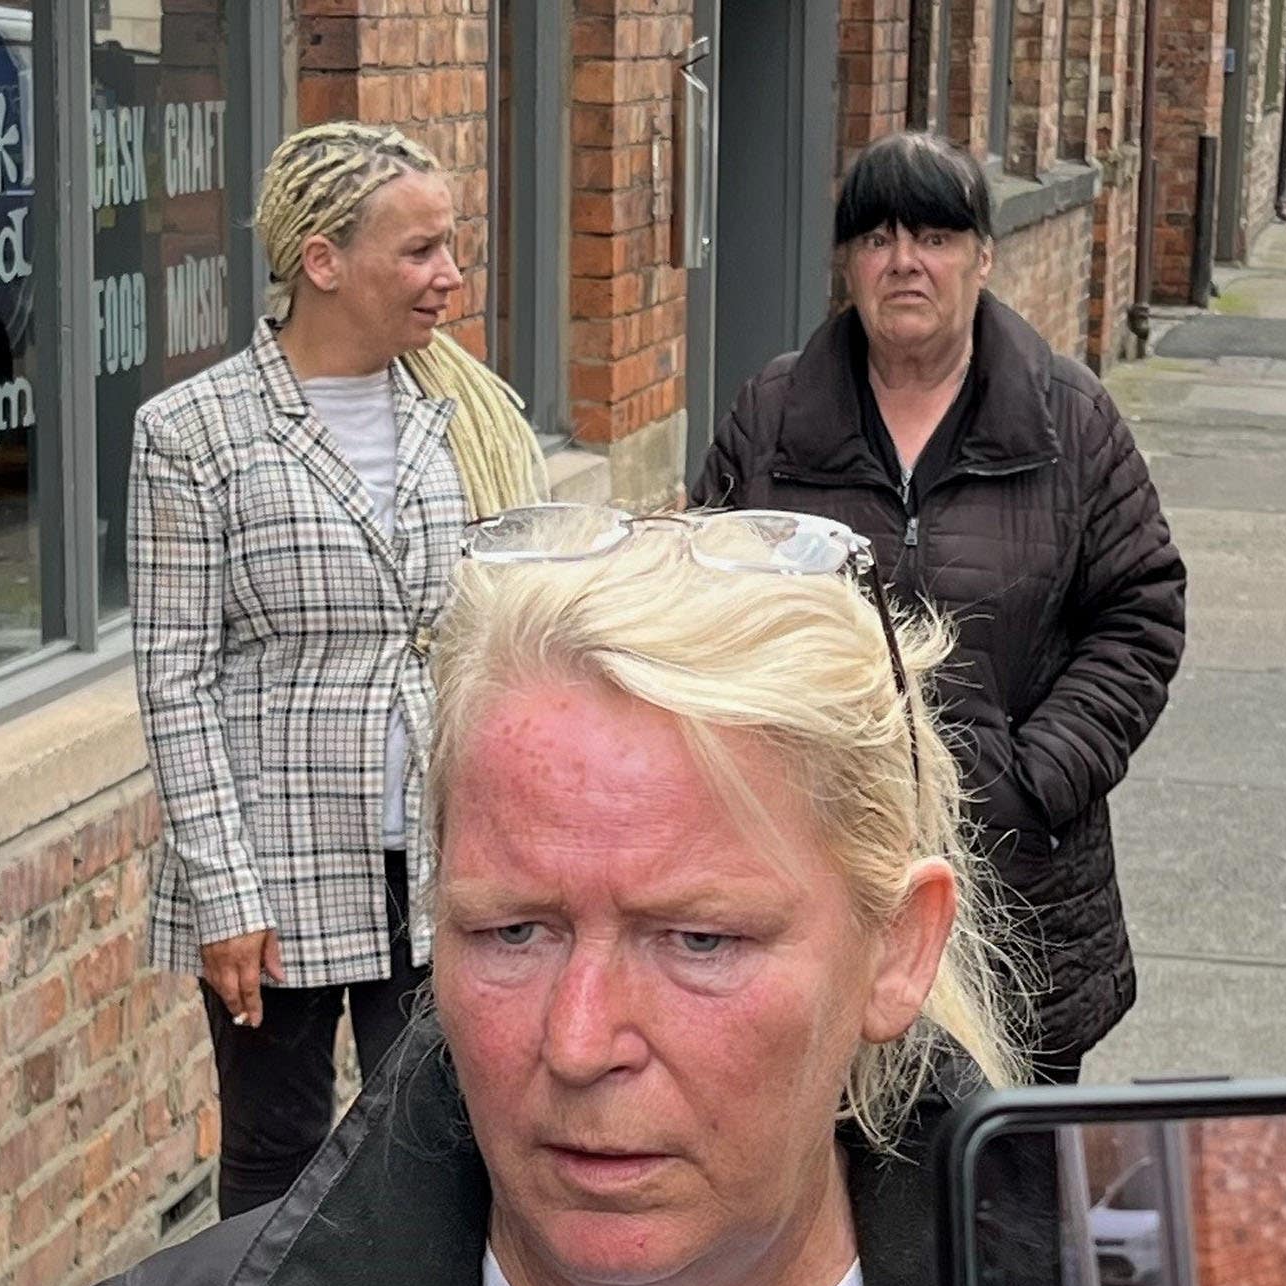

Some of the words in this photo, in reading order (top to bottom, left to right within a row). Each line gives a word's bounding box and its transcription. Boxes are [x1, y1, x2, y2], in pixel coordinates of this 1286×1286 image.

[91, 105, 148, 210] CASK
[165, 100, 227, 199] CRAFT
[93, 272, 148, 377] FOOD
[167, 254, 228, 358] MUSIC
